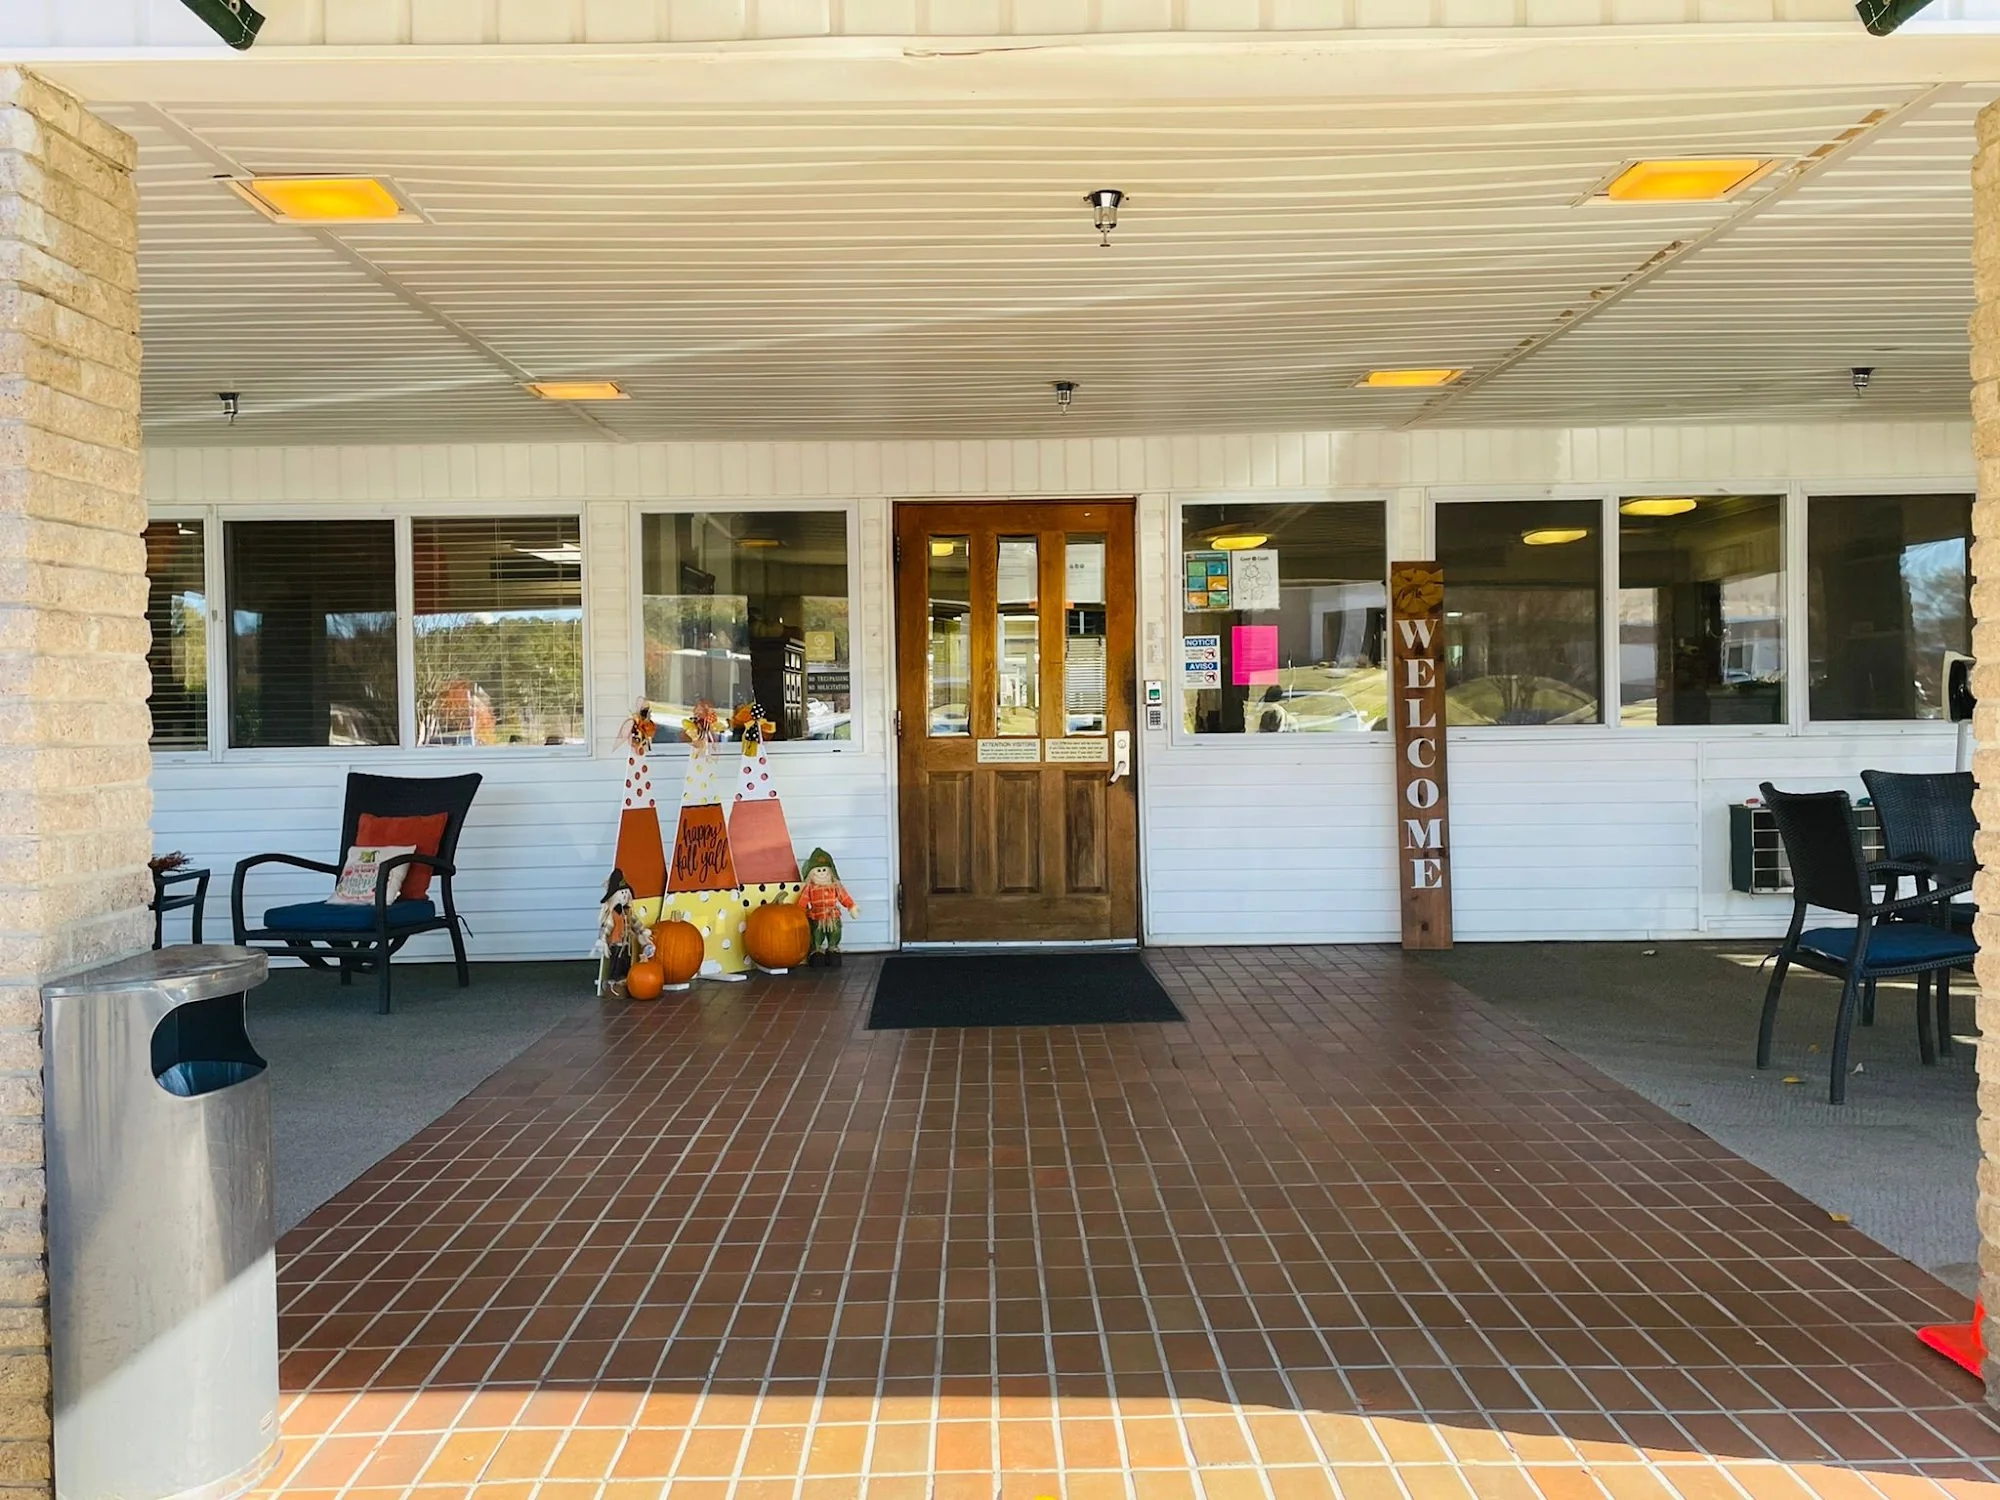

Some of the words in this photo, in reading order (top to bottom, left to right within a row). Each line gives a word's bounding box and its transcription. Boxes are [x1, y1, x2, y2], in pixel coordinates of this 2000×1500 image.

[1189, 662, 1214, 670] AVISO
[1396, 618, 1443, 889] WELCOME
[683, 818, 722, 849] happy
[676, 844, 698, 881] fall
